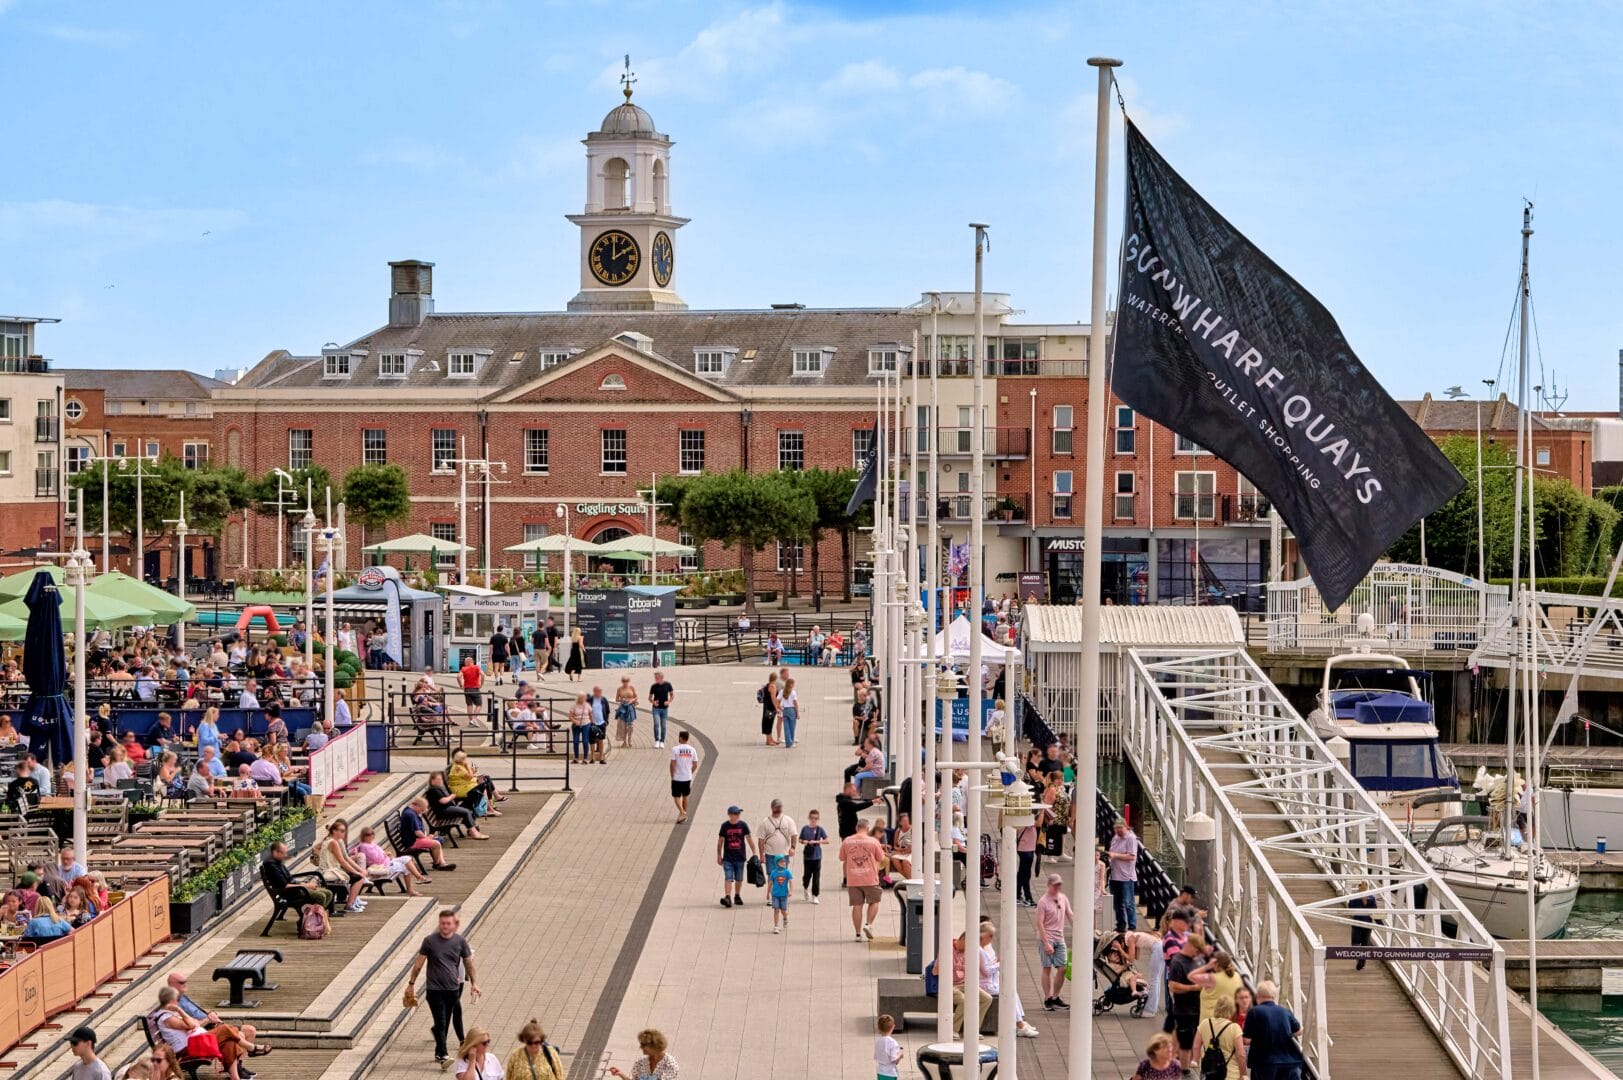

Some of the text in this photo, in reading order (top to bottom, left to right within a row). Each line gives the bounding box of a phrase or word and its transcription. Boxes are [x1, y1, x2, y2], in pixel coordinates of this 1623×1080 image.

[1126, 233, 1382, 504] GUNWHARF QUAYS
[1259, 419, 1321, 489] SHOPPING
[576, 503, 617, 516] Giggling
[1397, 565, 1421, 573] Board
[1422, 567, 1441, 577] Here
[502, 600, 519, 608] Tours
[628, 596, 658, 609] Onboard
[1335, 950, 1371, 958] WELCOME
[1384, 951, 1426, 959] GUNWHARF
[1427, 952, 1451, 960] QUAYS
